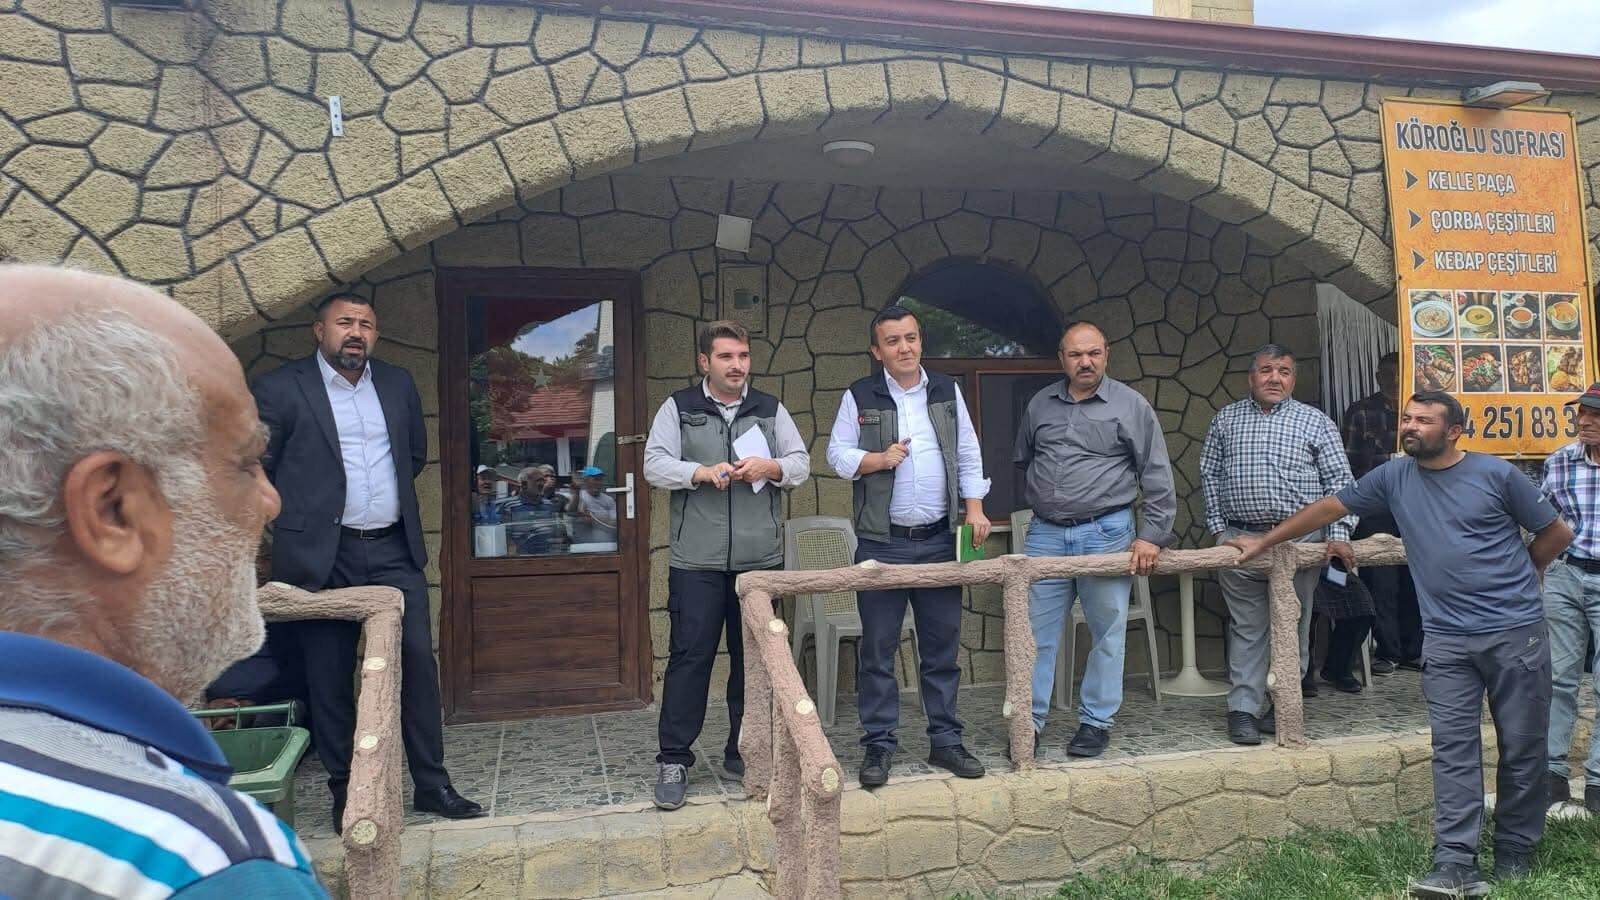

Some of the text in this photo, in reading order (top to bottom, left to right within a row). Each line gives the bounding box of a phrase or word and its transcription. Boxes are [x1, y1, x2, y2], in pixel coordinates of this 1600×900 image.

[1396, 117, 1566, 159] KÖROĞLU SOFRASI
[1428, 170, 1516, 197] KELLE PAÇA
[1431, 210, 1555, 236] ÇORBA ÇEŞİTLERİ
[1434, 250, 1557, 276] KEBAP ÇEŞİTLERİ
[1463, 406, 1579, 439] 4 251 83 3
